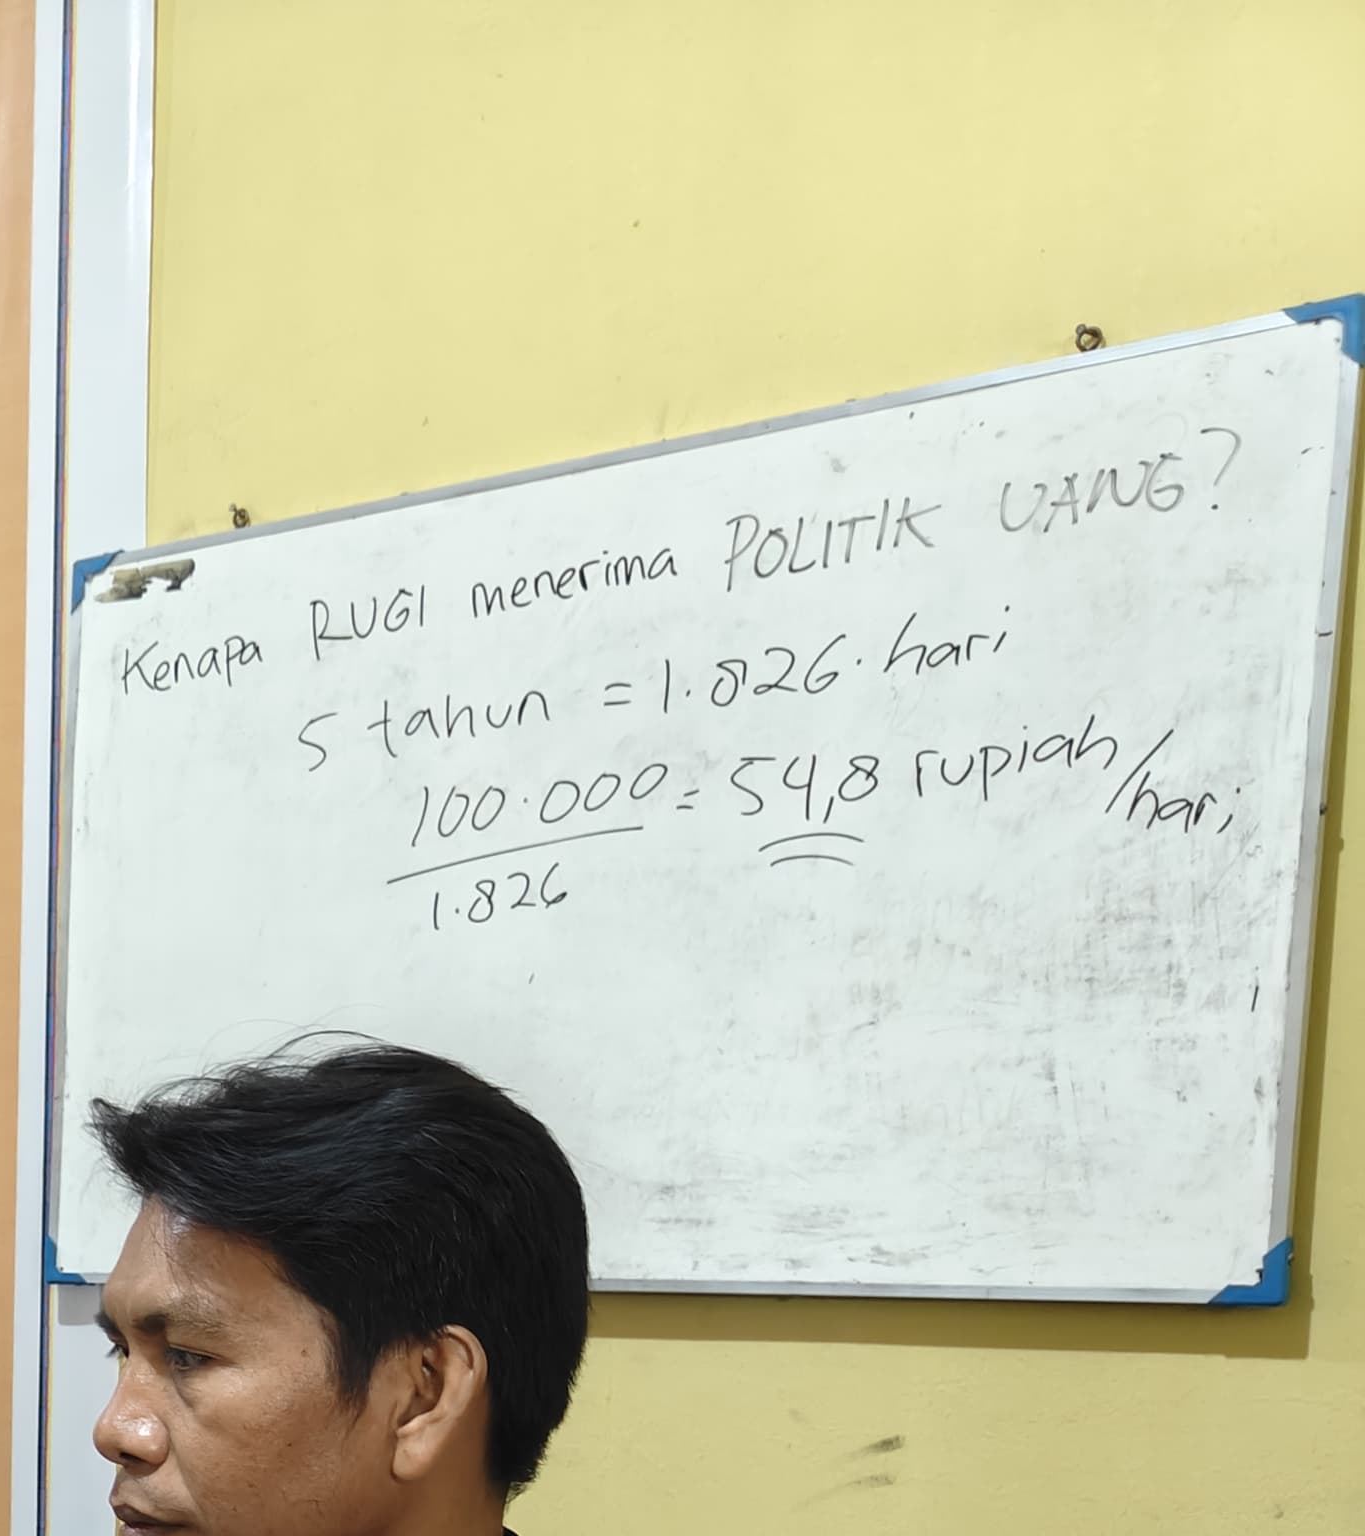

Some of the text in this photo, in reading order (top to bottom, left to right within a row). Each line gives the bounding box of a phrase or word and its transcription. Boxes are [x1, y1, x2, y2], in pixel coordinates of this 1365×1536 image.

[121, 635, 263, 695] Kenapa
[309, 585, 426, 661] RUGI
[472, 548, 678, 618] menerima
[724, 496, 942, 592] POLITIK
[367, 690, 550, 758] tahun
[884, 604, 1011, 674] hari
[434, 863, 568, 930] 1.826
